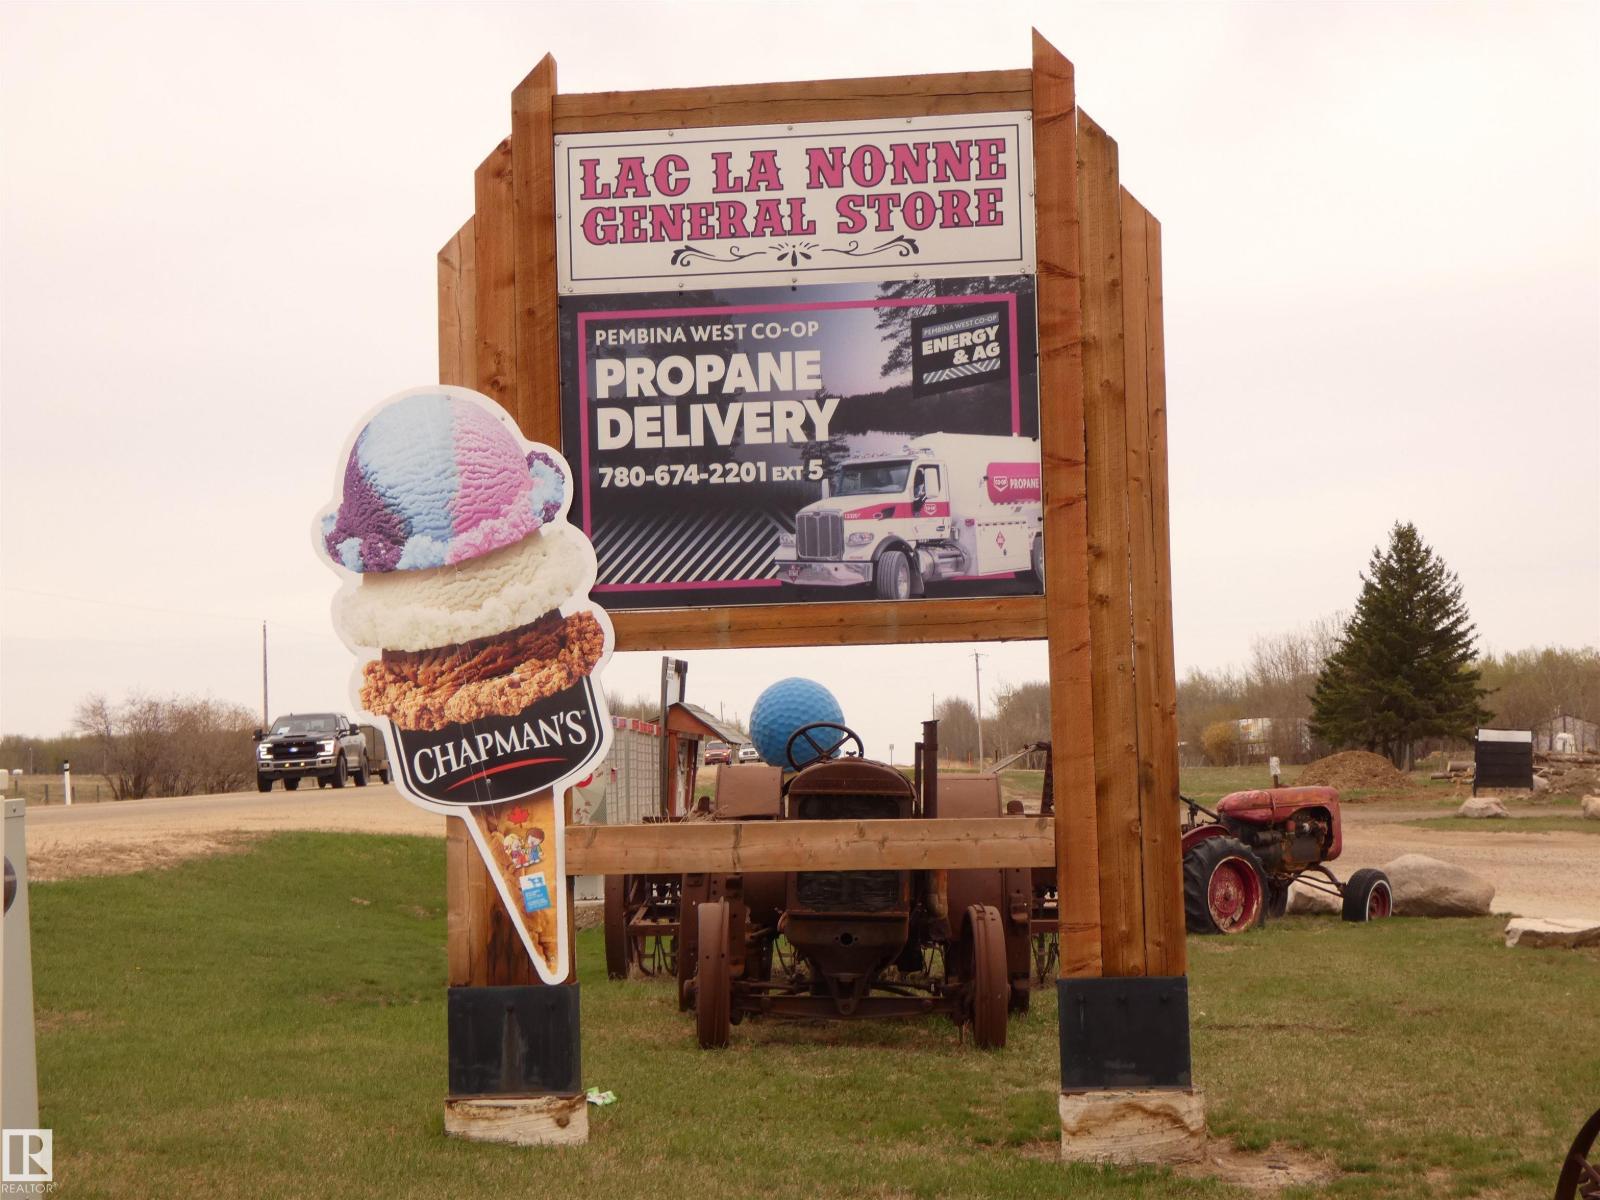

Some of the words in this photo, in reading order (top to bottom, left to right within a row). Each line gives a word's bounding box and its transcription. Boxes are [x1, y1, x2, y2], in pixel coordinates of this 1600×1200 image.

[579, 153, 691, 200] LAC
[711, 149, 784, 194] LA
[805, 138, 1007, 190] NONNE
[582, 197, 817, 246] GENERAL
[836, 188, 1004, 235] STORE
[595, 327, 687, 346] PEMBINA
[690, 324, 747, 342] WEST
[751, 321, 819, 340] CO-OP
[922, 325, 1000, 356] ENERGY
[952, 349, 970, 365] &
[972, 341, 1000, 361] AG
[595, 350, 822, 399] PROPANE
[597, 398, 841, 451] DELIVERY
[599, 461, 767, 488] 780-674-2201
[772, 466, 803, 481] EXT
[808, 459, 824, 480] 5
[1010, 478, 1040, 489] PROPANE
[413, 709, 587, 785] CHAPMAN'S
